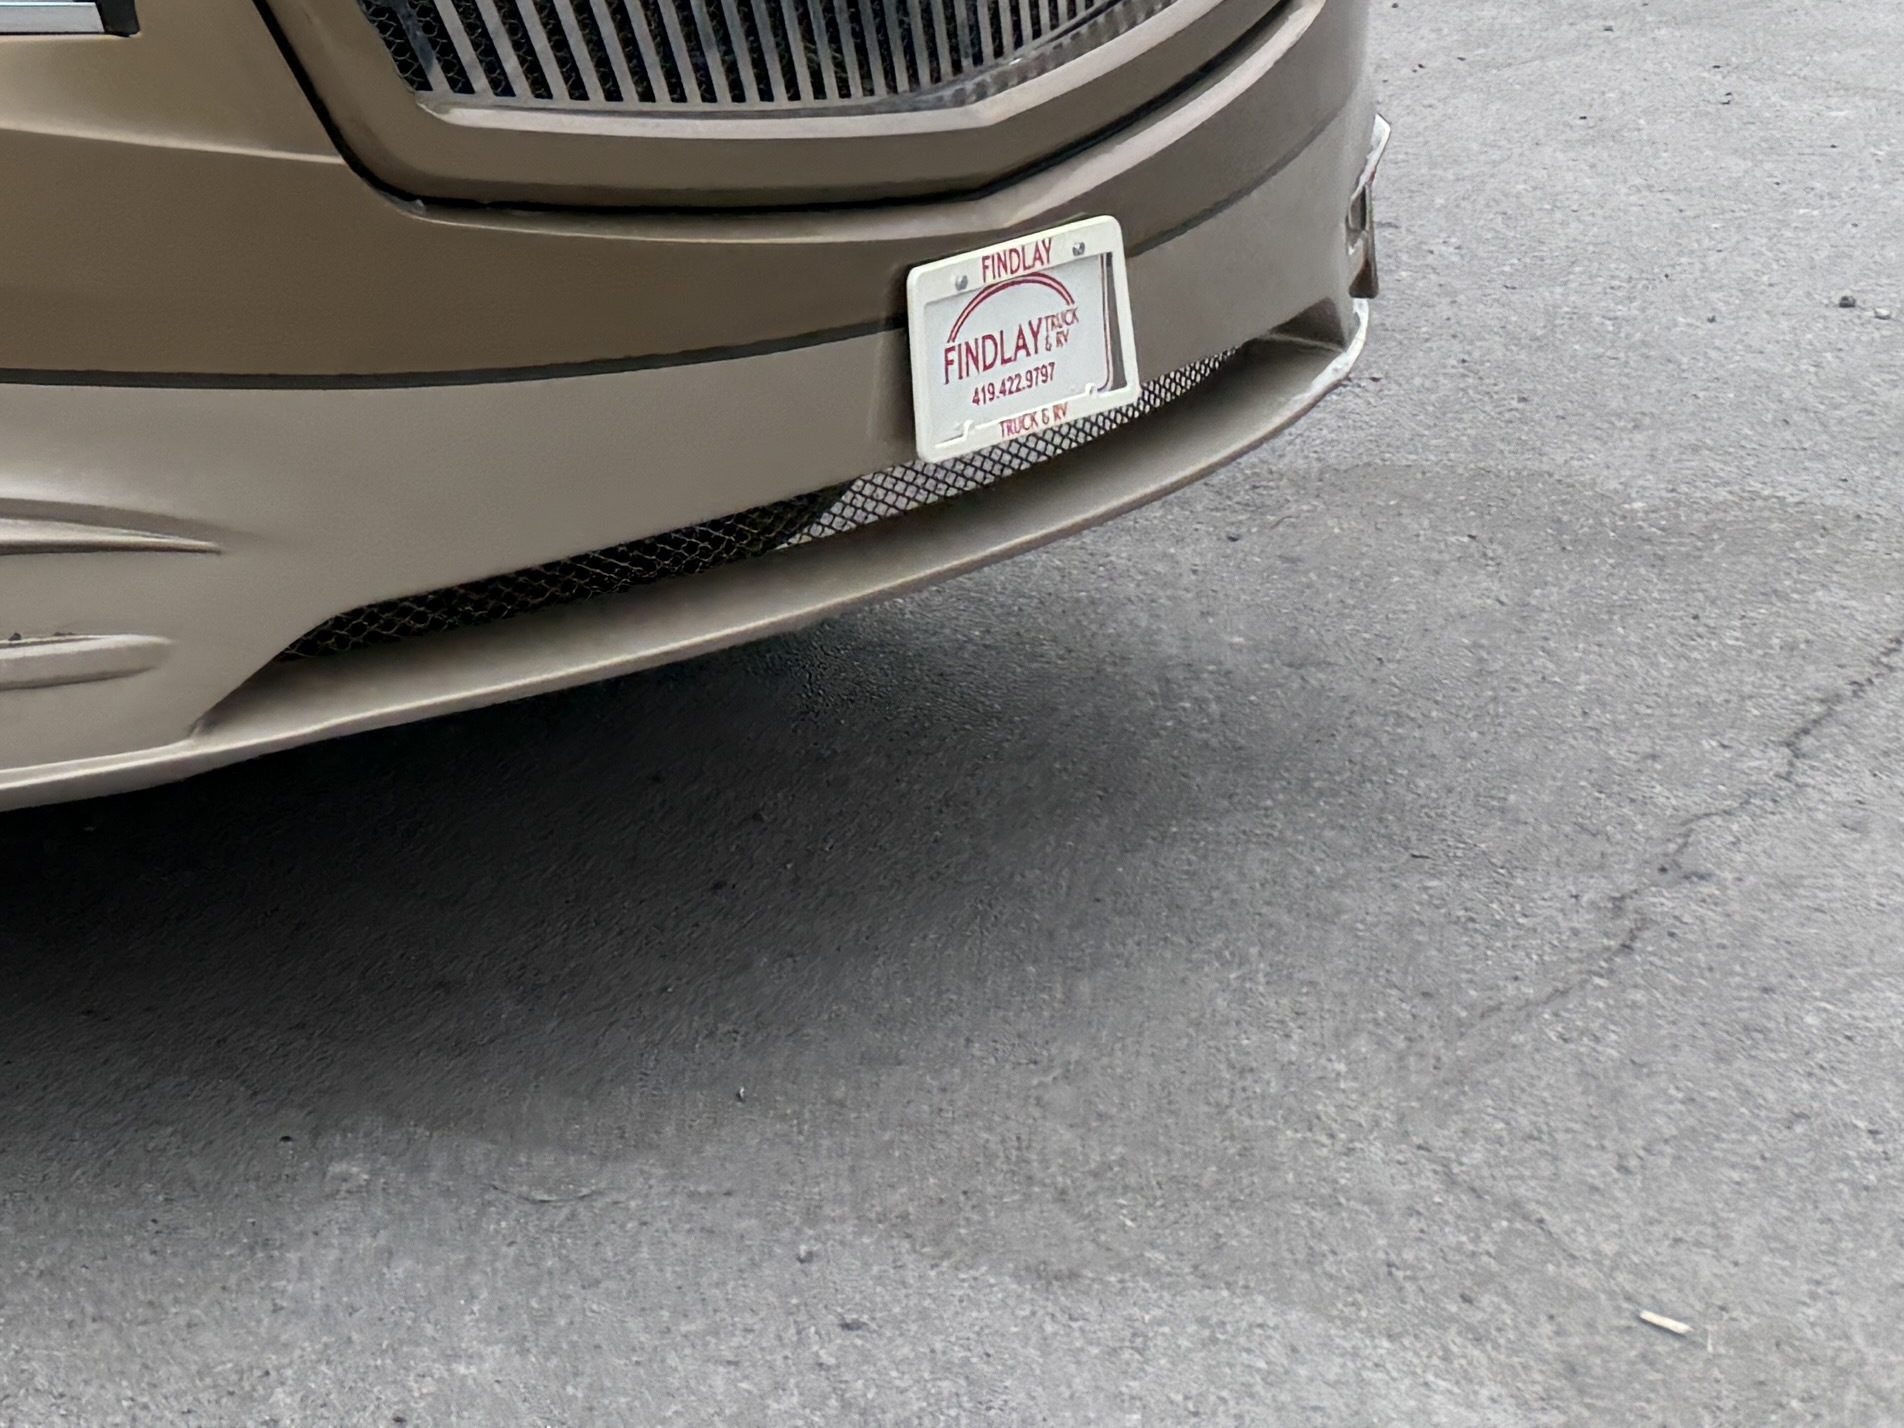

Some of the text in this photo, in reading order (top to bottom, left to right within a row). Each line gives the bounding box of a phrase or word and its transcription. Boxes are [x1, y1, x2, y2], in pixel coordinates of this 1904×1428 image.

[980, 237, 1053, 284] FINDLAY
[1044, 306, 1080, 334] TRUCK
[1055, 328, 1070, 349] RV
[943, 316, 1043, 385] FINDLAY
[971, 361, 1056, 407] 419.422.9797
[998, 407, 1039, 439] TRUCK
[1053, 401, 1069, 423] RV
